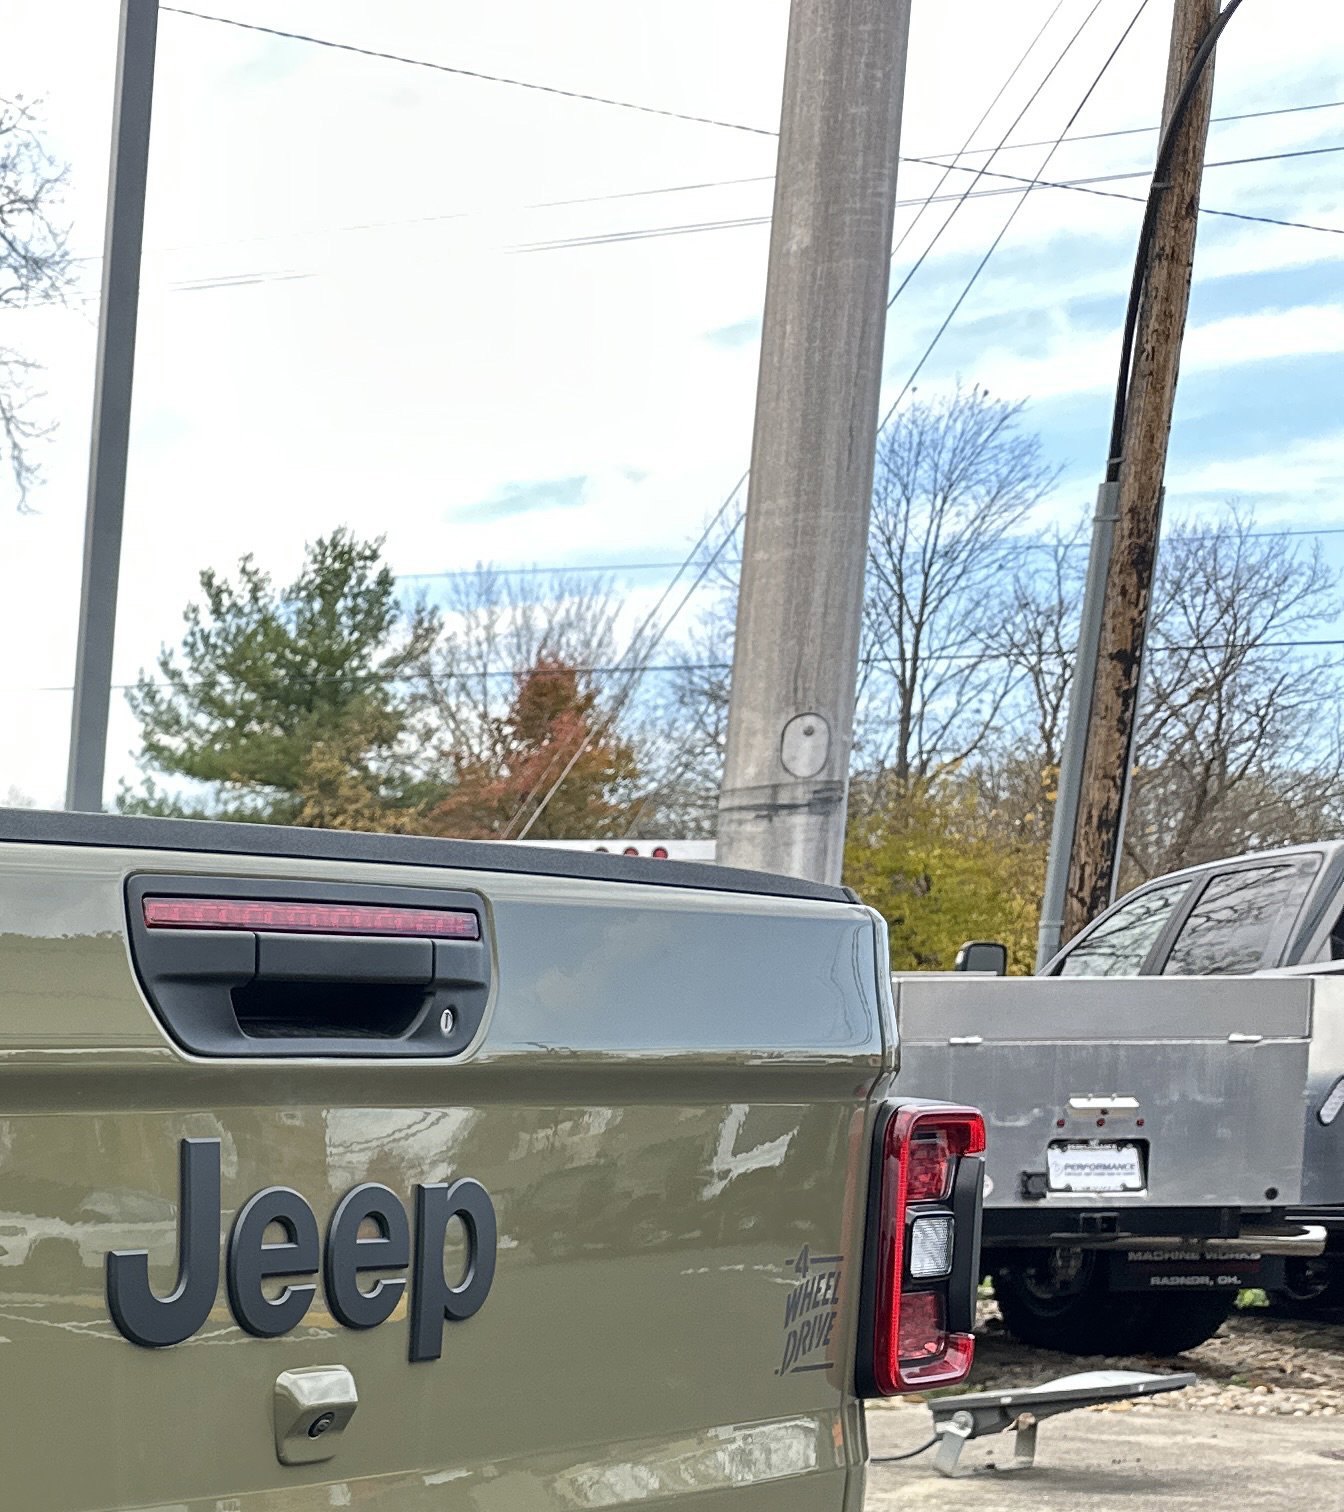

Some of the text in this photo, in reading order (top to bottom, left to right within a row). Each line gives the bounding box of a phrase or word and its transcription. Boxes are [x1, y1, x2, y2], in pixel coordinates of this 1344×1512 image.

[1064, 1162, 1136, 1171] PERFORMANCE
[106, 1137, 498, 1363] Jeep
[794, 1244, 810, 1278] 4
[784, 1271, 841, 1330] WHEEL
[779, 1311, 838, 1377] DRIVE
